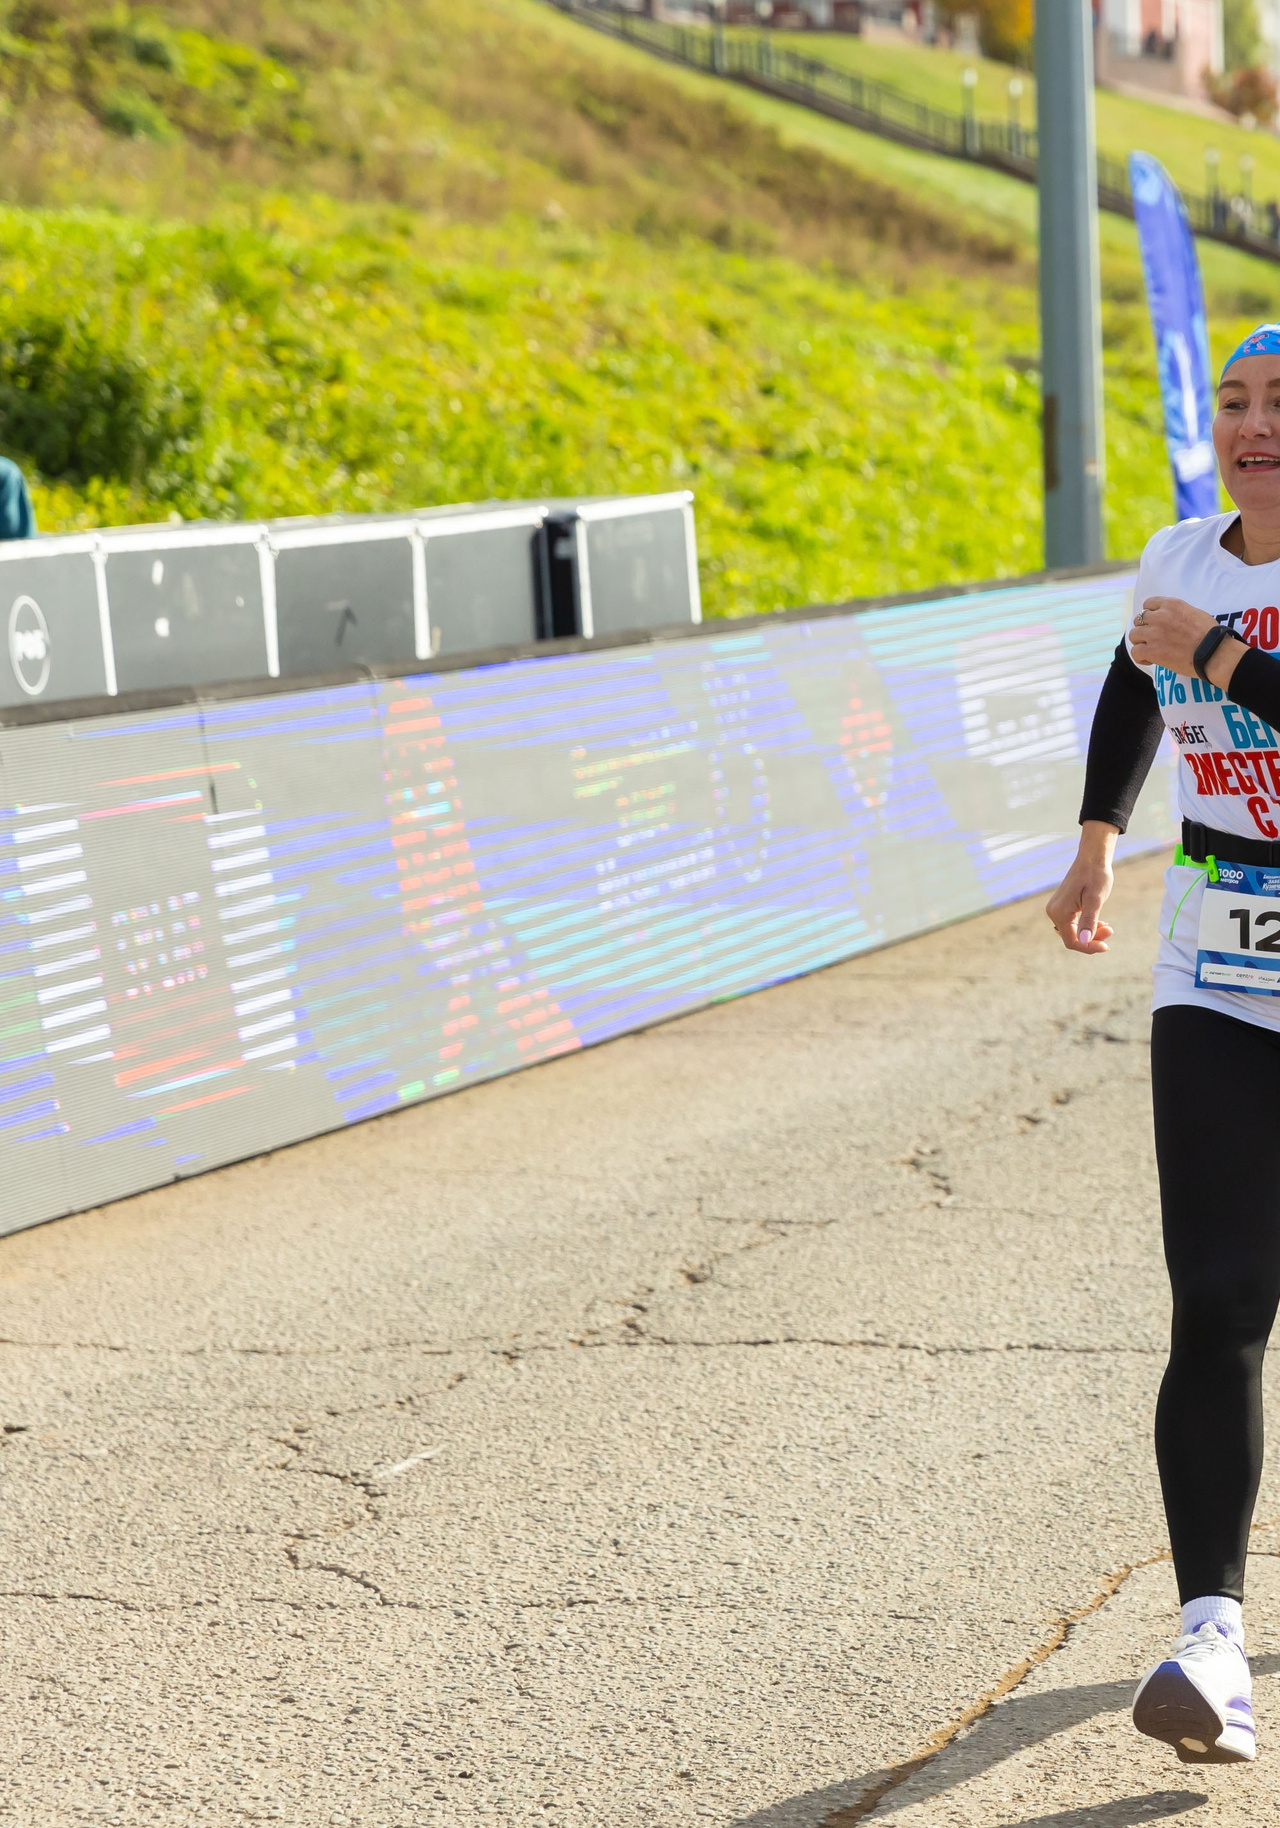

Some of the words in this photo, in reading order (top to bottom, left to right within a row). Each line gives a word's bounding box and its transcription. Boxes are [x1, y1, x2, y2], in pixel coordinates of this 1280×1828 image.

[1154, 664, 1187, 707] 5%
[1247, 796, 1279, 838] С
[1218, 868, 1244, 880] 1000
